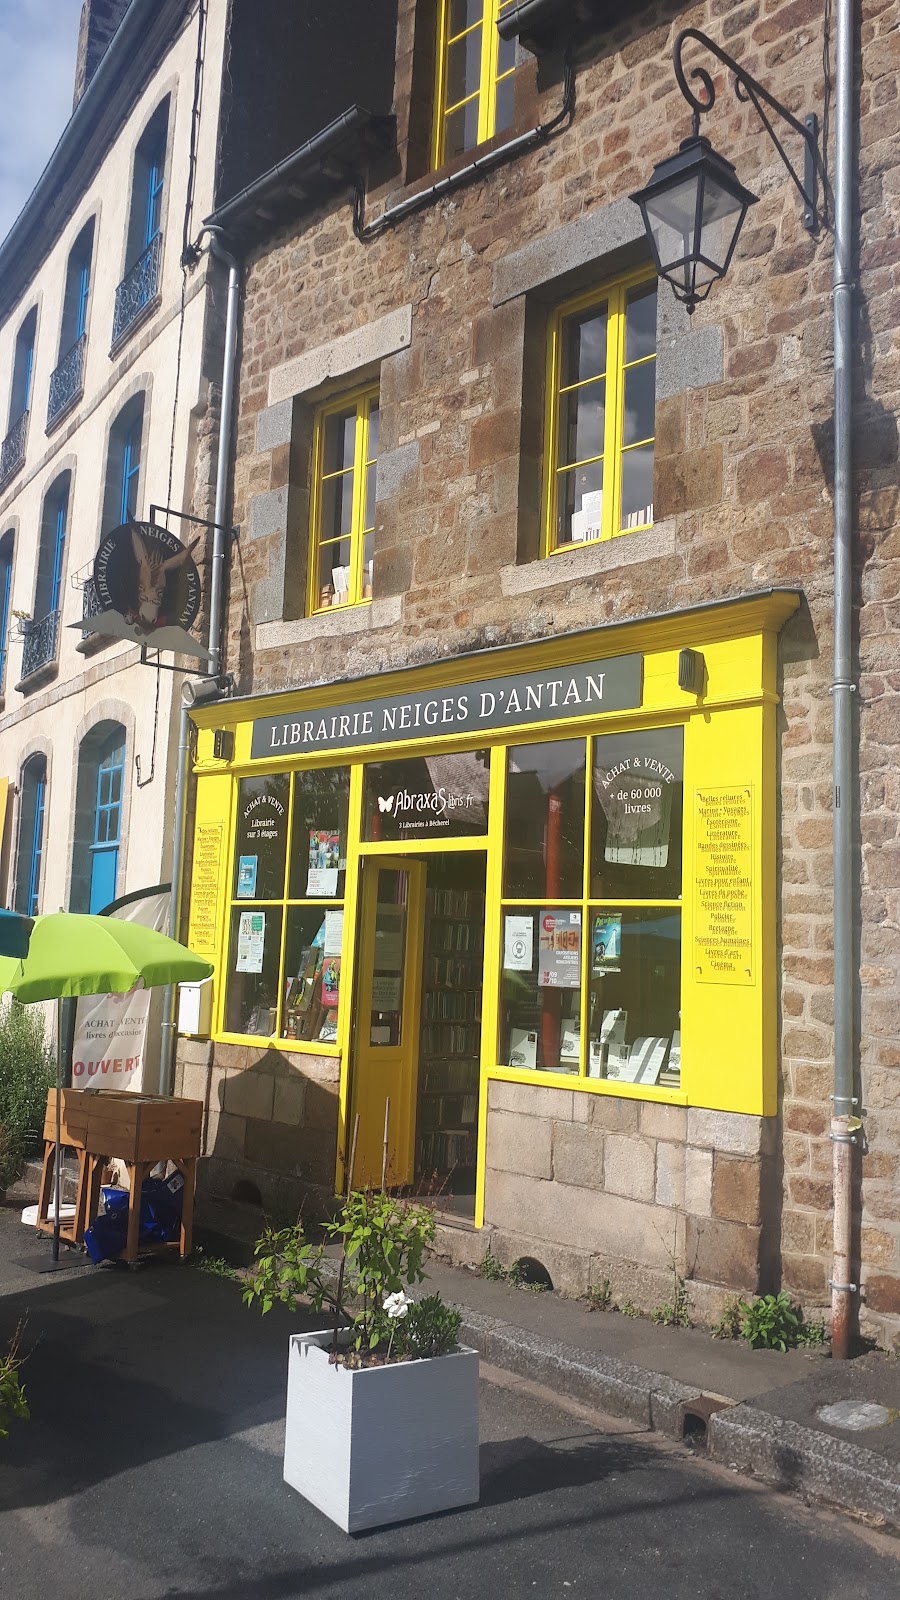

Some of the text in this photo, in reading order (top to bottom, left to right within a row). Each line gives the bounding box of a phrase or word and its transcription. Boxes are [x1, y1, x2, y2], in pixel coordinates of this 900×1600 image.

[98, 525, 196, 625] LIBRAIRIE NEIGES D'ANTAN
[270, 673, 606, 747] LIBRAIRIE NEIGES D'ANTAN
[601, 757, 675, 789] ACHAT & VENTE
[617, 789, 628, 800] de
[631, 789, 642, 799] 60
[644, 787, 662, 798] 000
[243, 795, 285, 819] ACHAT & VENTE
[625, 803, 651, 814] livres
[251, 817, 275, 828] Librairie
[403, 820, 425, 829] Librairies
[429, 819, 450, 827] Bécherel
[261, 829, 278, 840] étages
[84, 1019, 115, 1028] ACHAT
[86, 1031, 107, 1040] livres
[73, 1055, 141, 1077] OUVERT
